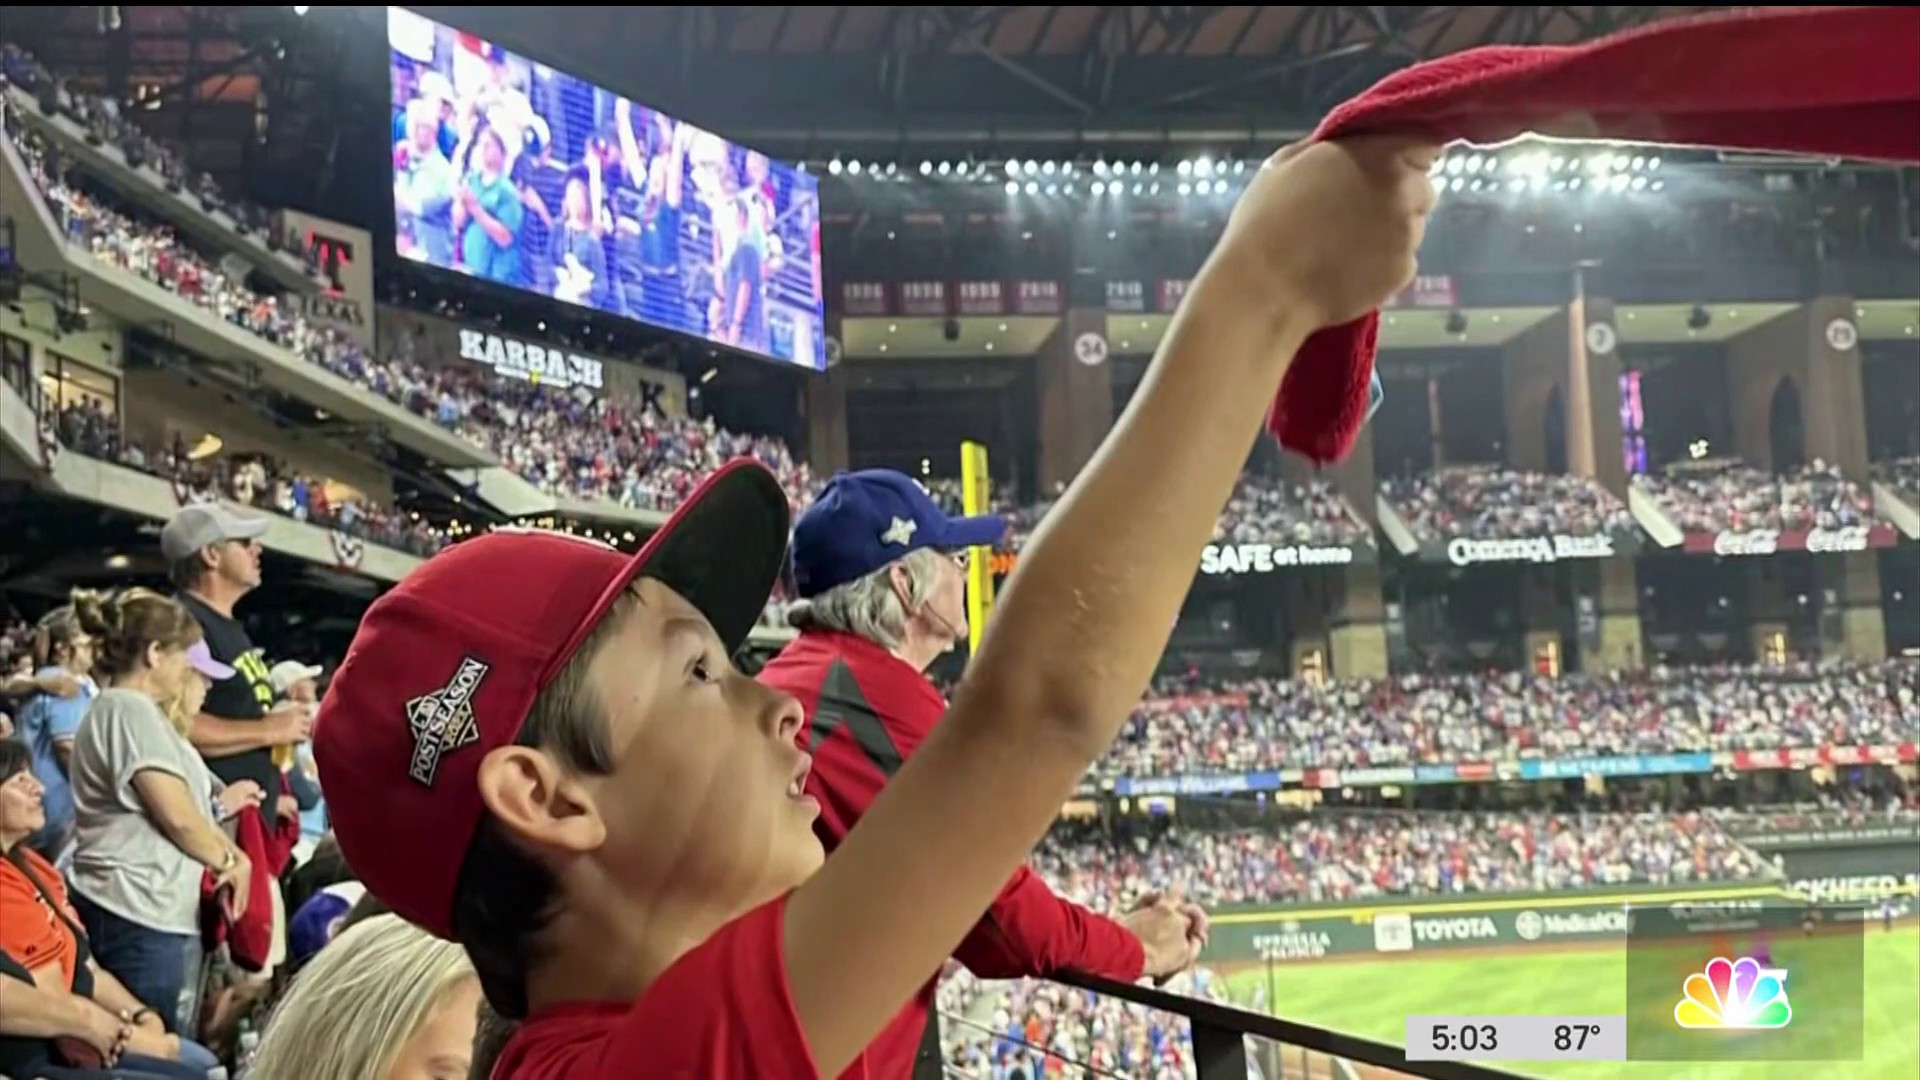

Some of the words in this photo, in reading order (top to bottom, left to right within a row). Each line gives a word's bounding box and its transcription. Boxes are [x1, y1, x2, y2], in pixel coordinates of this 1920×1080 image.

[459, 329, 603, 389] KARBACH
[1201, 544, 1274, 574] SAFE
[1273, 547, 1299, 565] at
[413, 659, 483, 783] POSTSEASON
[1413, 916, 1497, 941] TOYOTA
